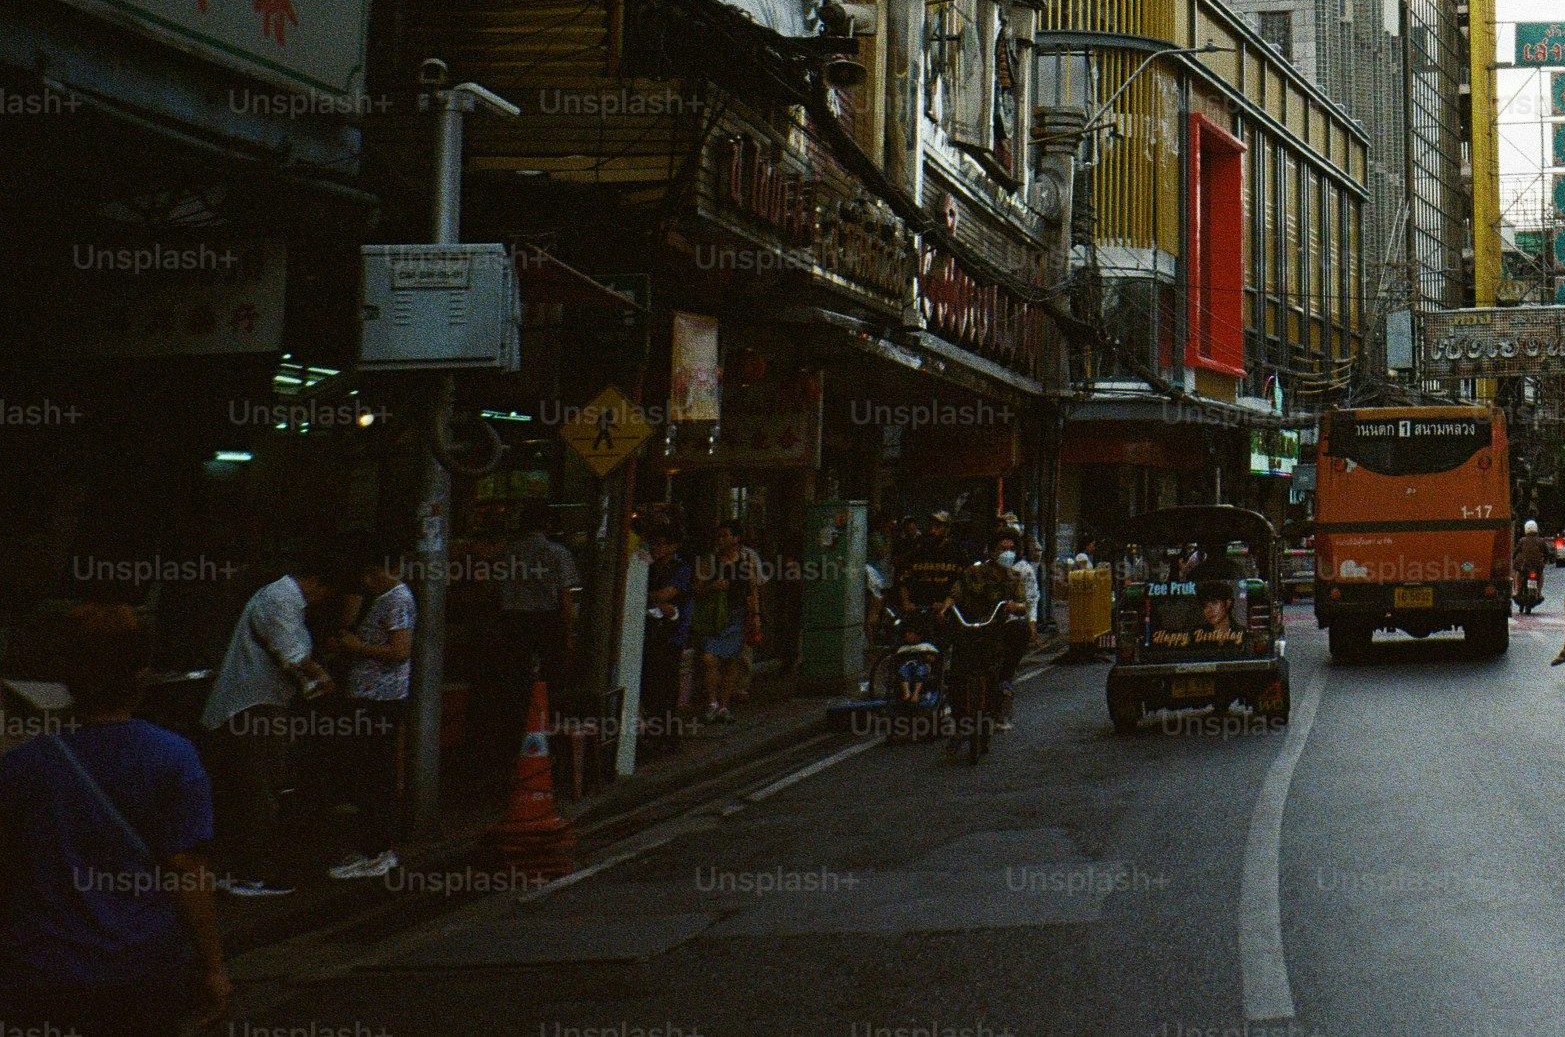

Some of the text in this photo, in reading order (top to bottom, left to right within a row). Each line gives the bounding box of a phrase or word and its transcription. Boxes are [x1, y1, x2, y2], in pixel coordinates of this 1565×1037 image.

[1413, 421, 1476, 437] สนามหลวง
[1460, 505, 1494, 519] 1-17
[1148, 581, 1198, 596] Zee Pruk
[1152, 628, 1244, 648] Happy Birthday
